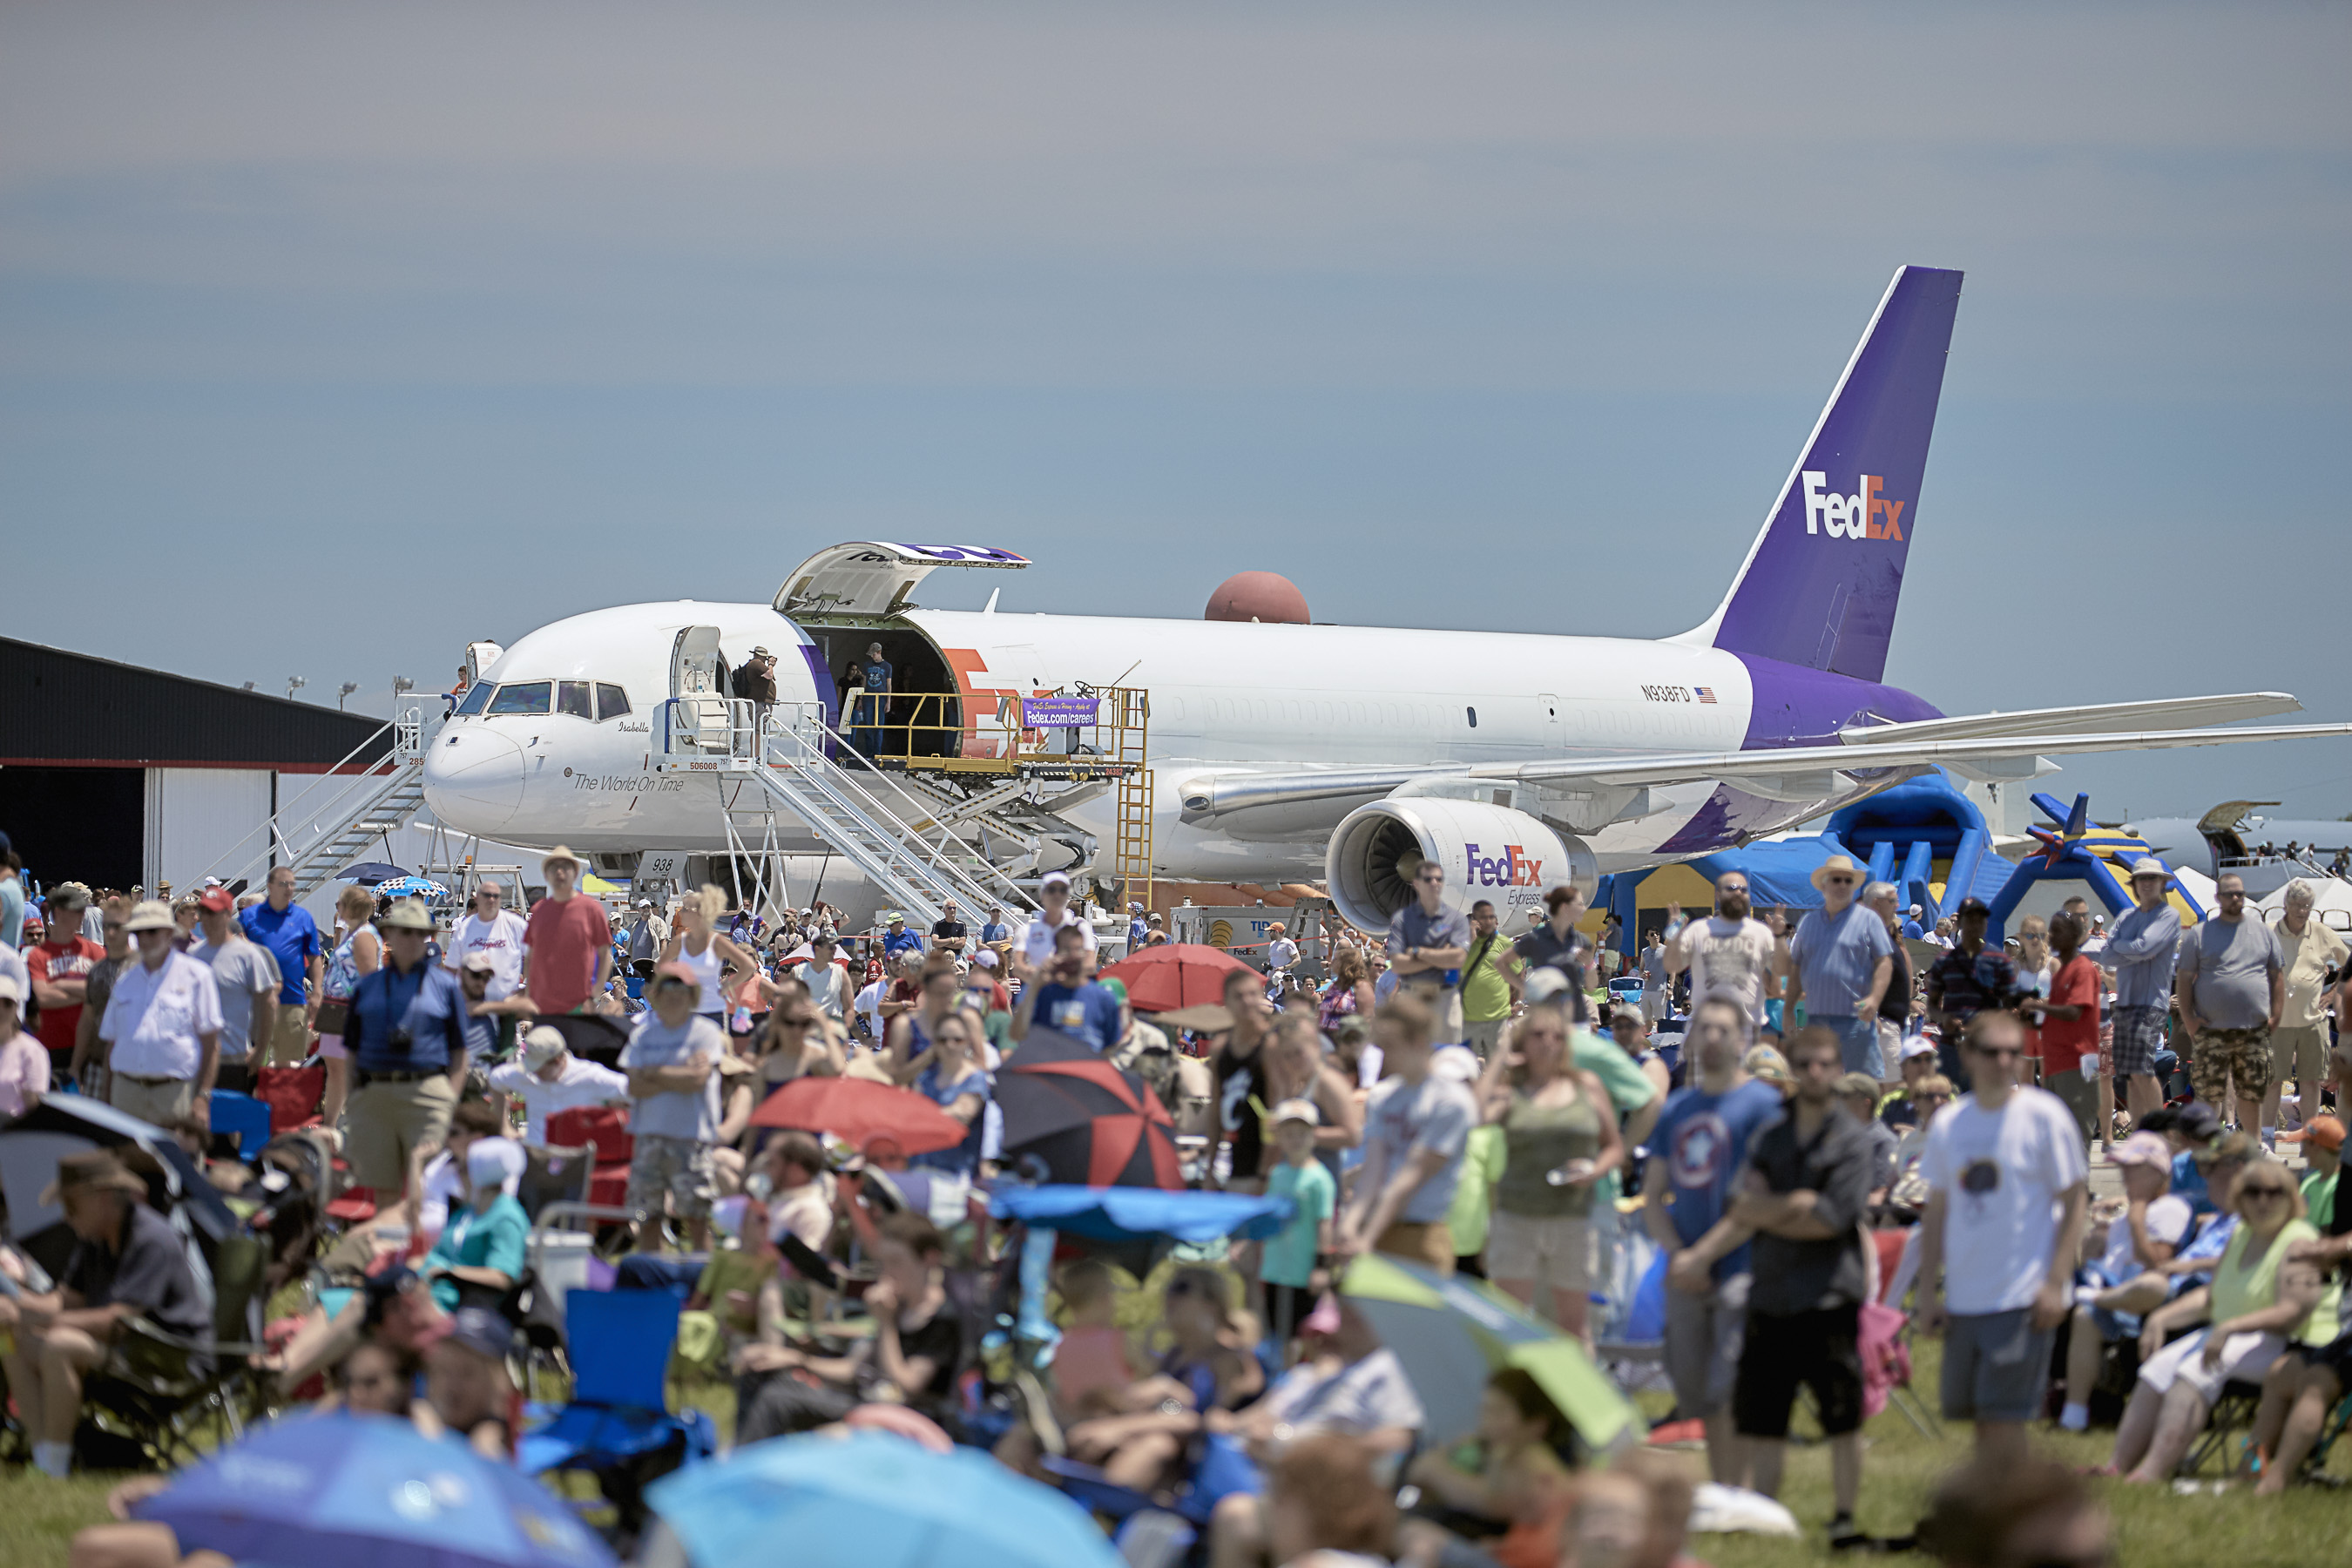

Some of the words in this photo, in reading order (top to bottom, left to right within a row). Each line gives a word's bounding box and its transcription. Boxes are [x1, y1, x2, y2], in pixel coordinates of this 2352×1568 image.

[1801, 470, 1905, 541] FedEx
[1641, 685, 1691, 702] N938FD
[1027, 711, 1094, 724] Fedex.com/carees
[618, 721, 649, 733] Isabella
[575, 773, 598, 791] The
[600, 775, 639, 792] World
[638, 776, 655, 792] On
[658, 776, 684, 792] Time
[652, 858, 673, 871] 938
[1465, 843, 1542, 887] FedEx
[1508, 889, 1540, 908] Express
